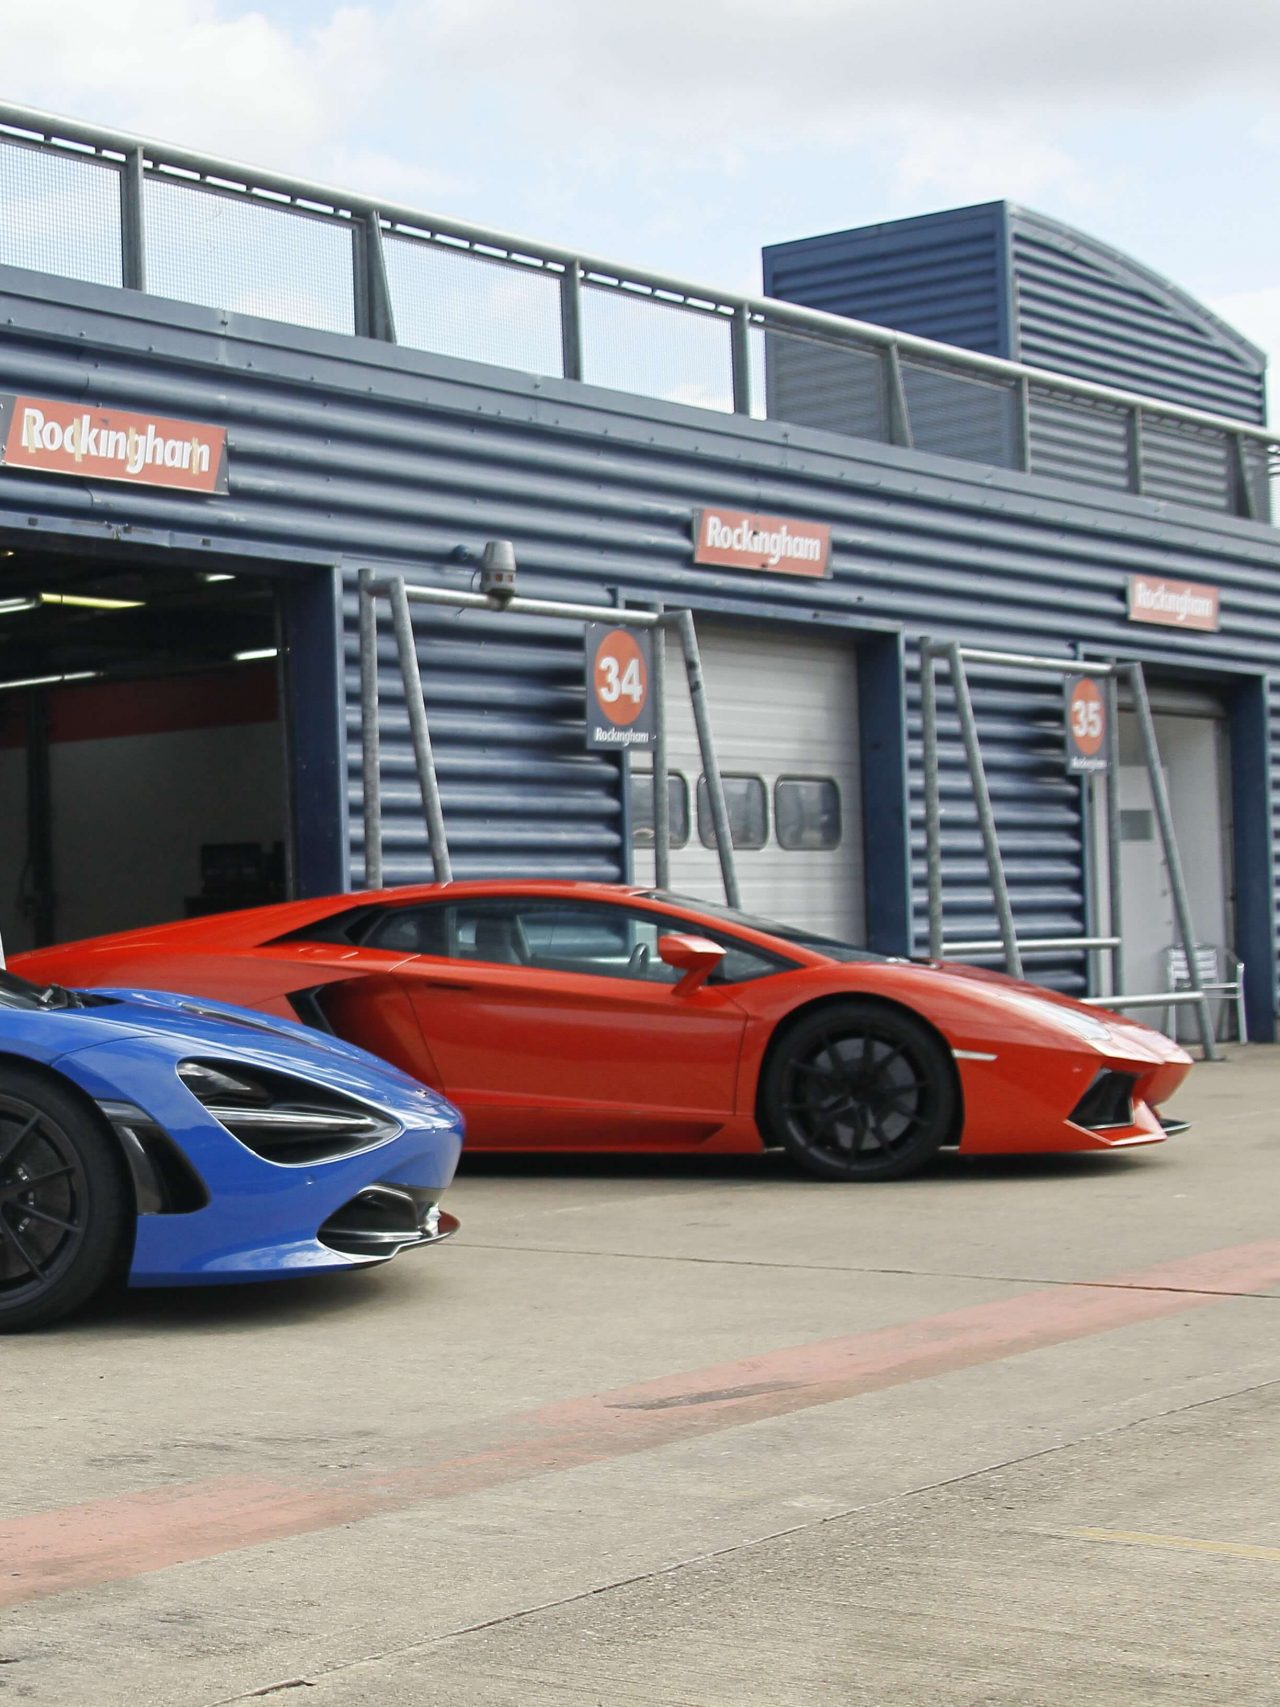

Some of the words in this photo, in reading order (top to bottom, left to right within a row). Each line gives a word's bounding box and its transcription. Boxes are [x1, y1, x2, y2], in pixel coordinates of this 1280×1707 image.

[22, 408, 210, 474] Rockingham
[707, 517, 820, 564] Rockingham
[600, 657, 642, 703] 34
[595, 727, 649, 746] Rockingham
[1072, 701, 1101, 737] 35
